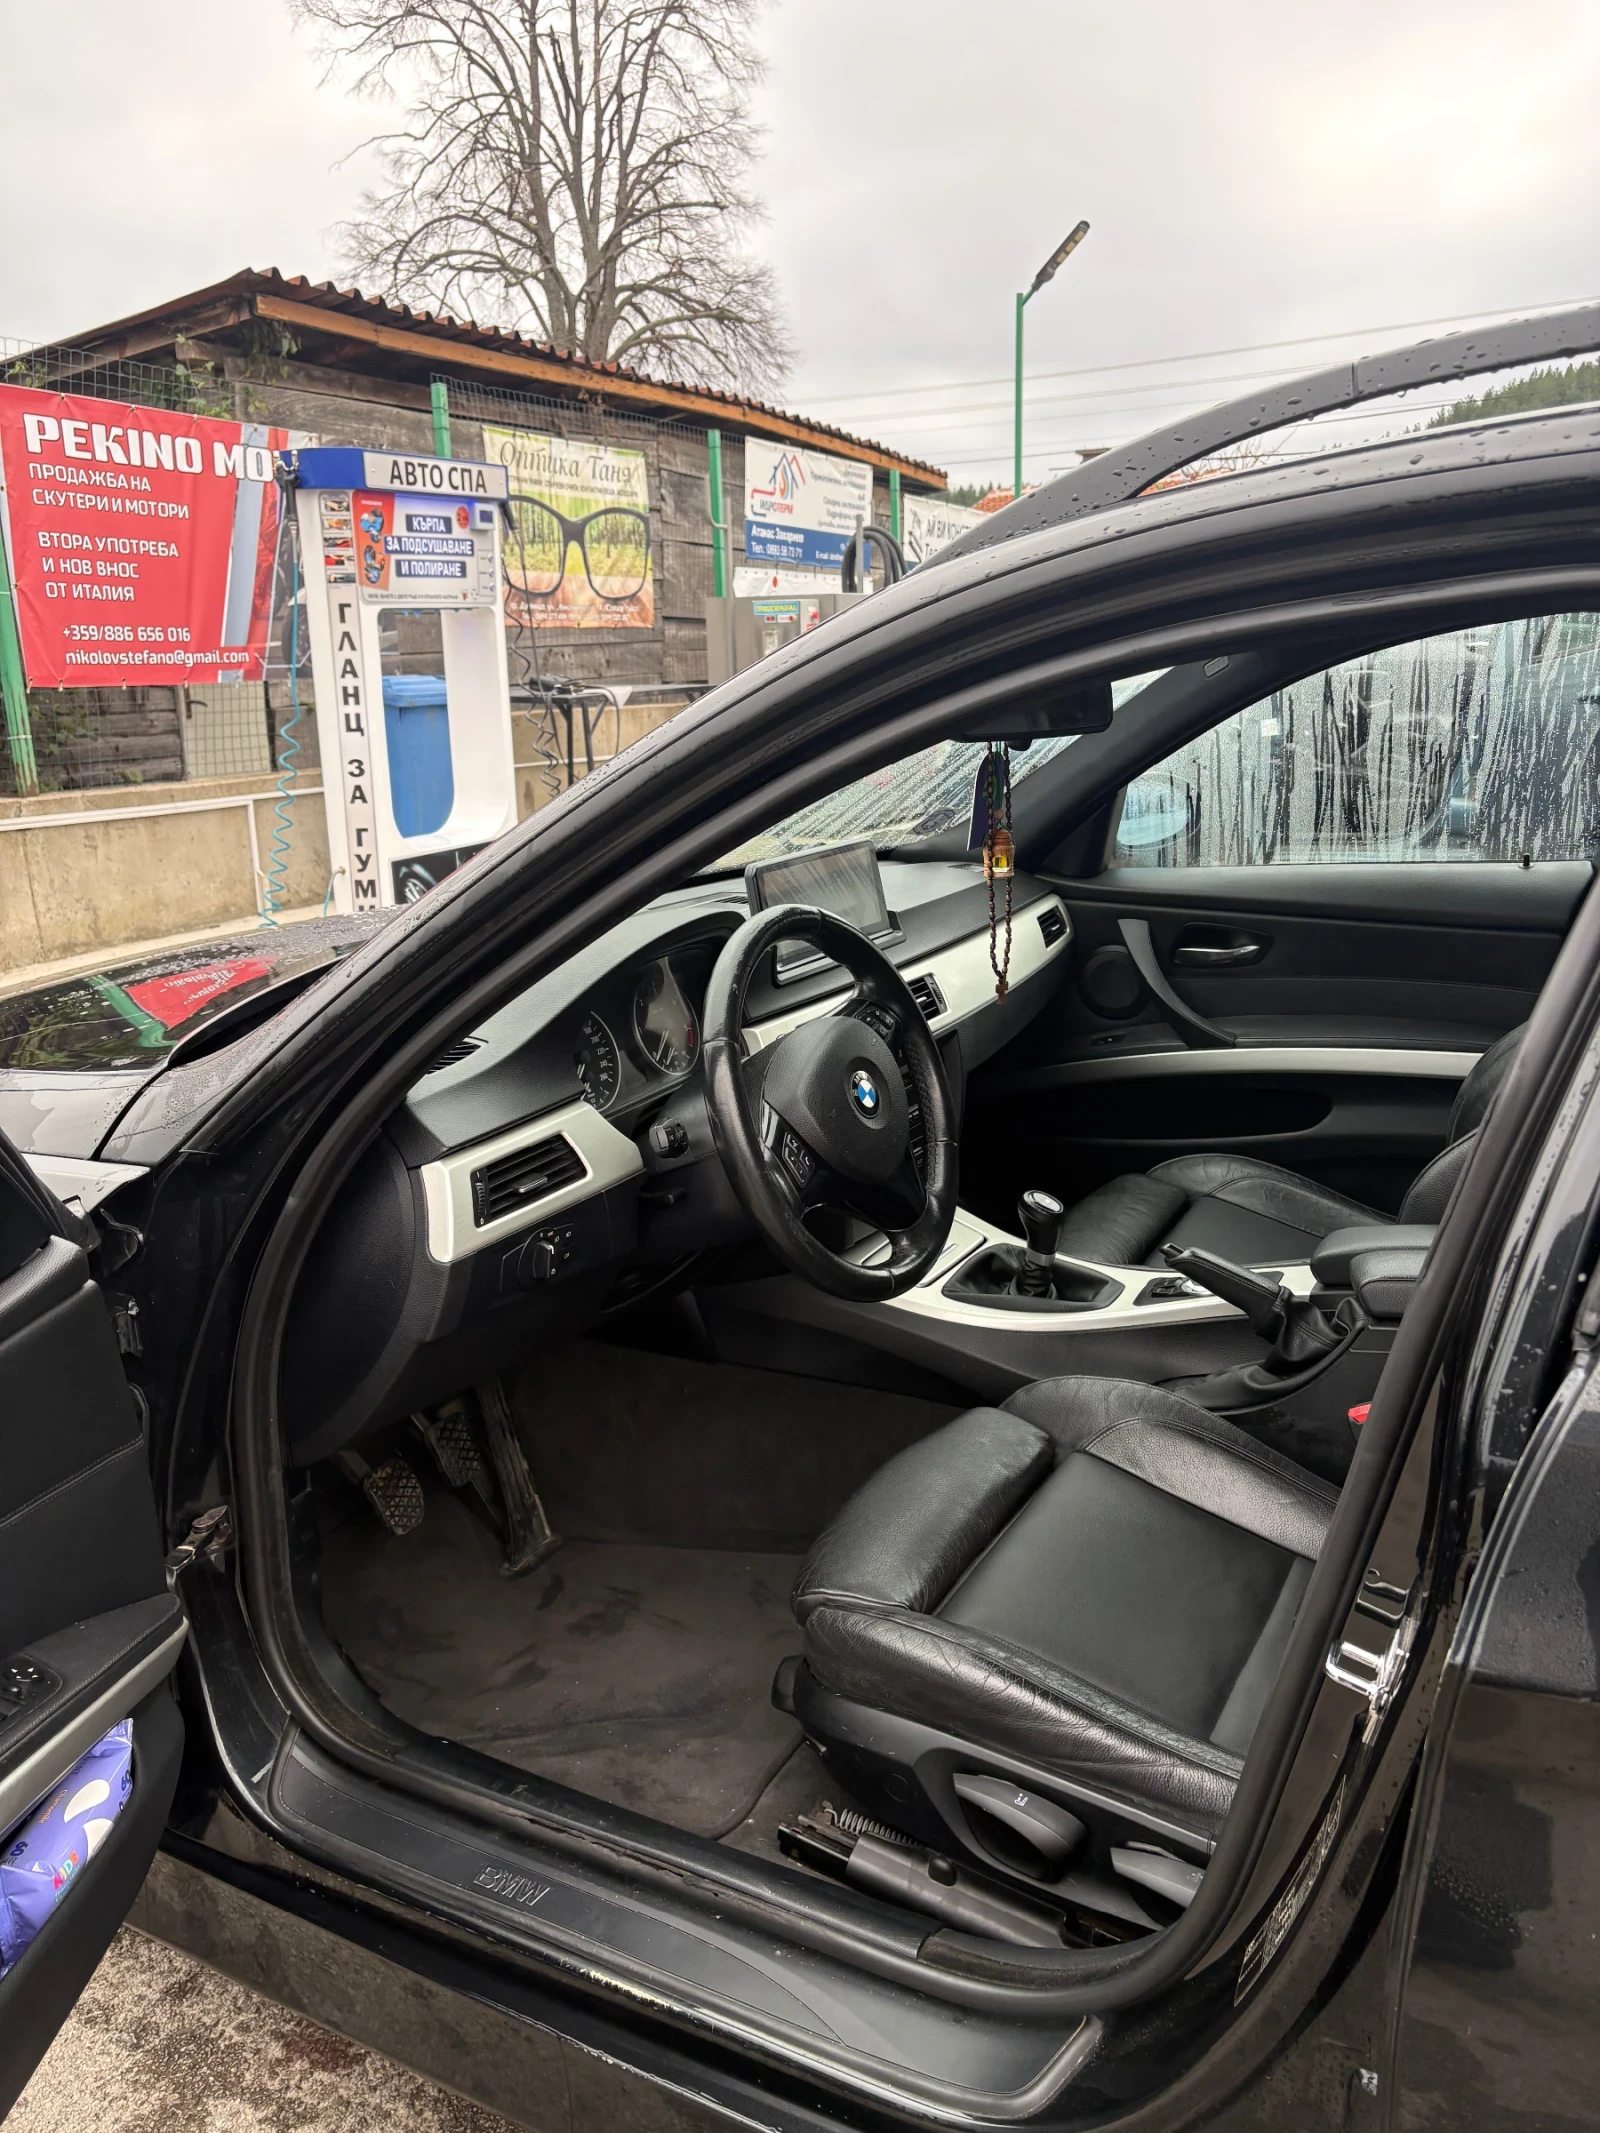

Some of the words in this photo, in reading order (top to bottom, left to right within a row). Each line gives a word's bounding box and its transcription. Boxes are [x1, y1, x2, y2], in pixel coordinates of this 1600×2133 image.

[23, 413, 203, 474] PEKINO
[213, 442, 274, 482] MO
[390, 459, 443, 489] АВТО
[448, 467, 488, 493] СПА
[500, 441, 581, 477] Оптика
[587, 455, 635, 484] Таня
[29, 463, 128, 491] ПРОДАЖБА
[131, 476, 151, 492] НА
[33, 489, 108, 511] СКУТЕРИ
[112, 497, 122, 512] И
[125, 499, 190, 519] МОТОРИ
[412, 516, 446, 532] КЪРПА
[38, 532, 92, 550] ВТОРА
[95, 536, 179, 557] УПОТРЕБА
[386, 537, 400, 550] ЗА
[402, 538, 472, 555] ПОДСУШАВАНЕ
[42, 557, 55, 573] И
[59, 559, 92, 575] НОВ
[96, 562, 140, 578] ВНОС
[401, 561, 409, 574] И
[410, 562, 461, 577] ПОЛИРАНЕ
[45, 581, 66, 598] ОТ
[72, 584, 135, 601] ИТАЛИЯ
[62, 624, 133, 642] +359/886
[137, 626, 164, 641] 656
[167, 627, 191, 642] 016
[66, 649, 250, 667] nikolovstefano@gmail.com
[338, 603, 365, 736] ГЛАНЦ
[347, 759, 369, 804] ЗА
[53, 1850, 79, 1890] KIDS
[473, 1865, 551, 1906] BMW
